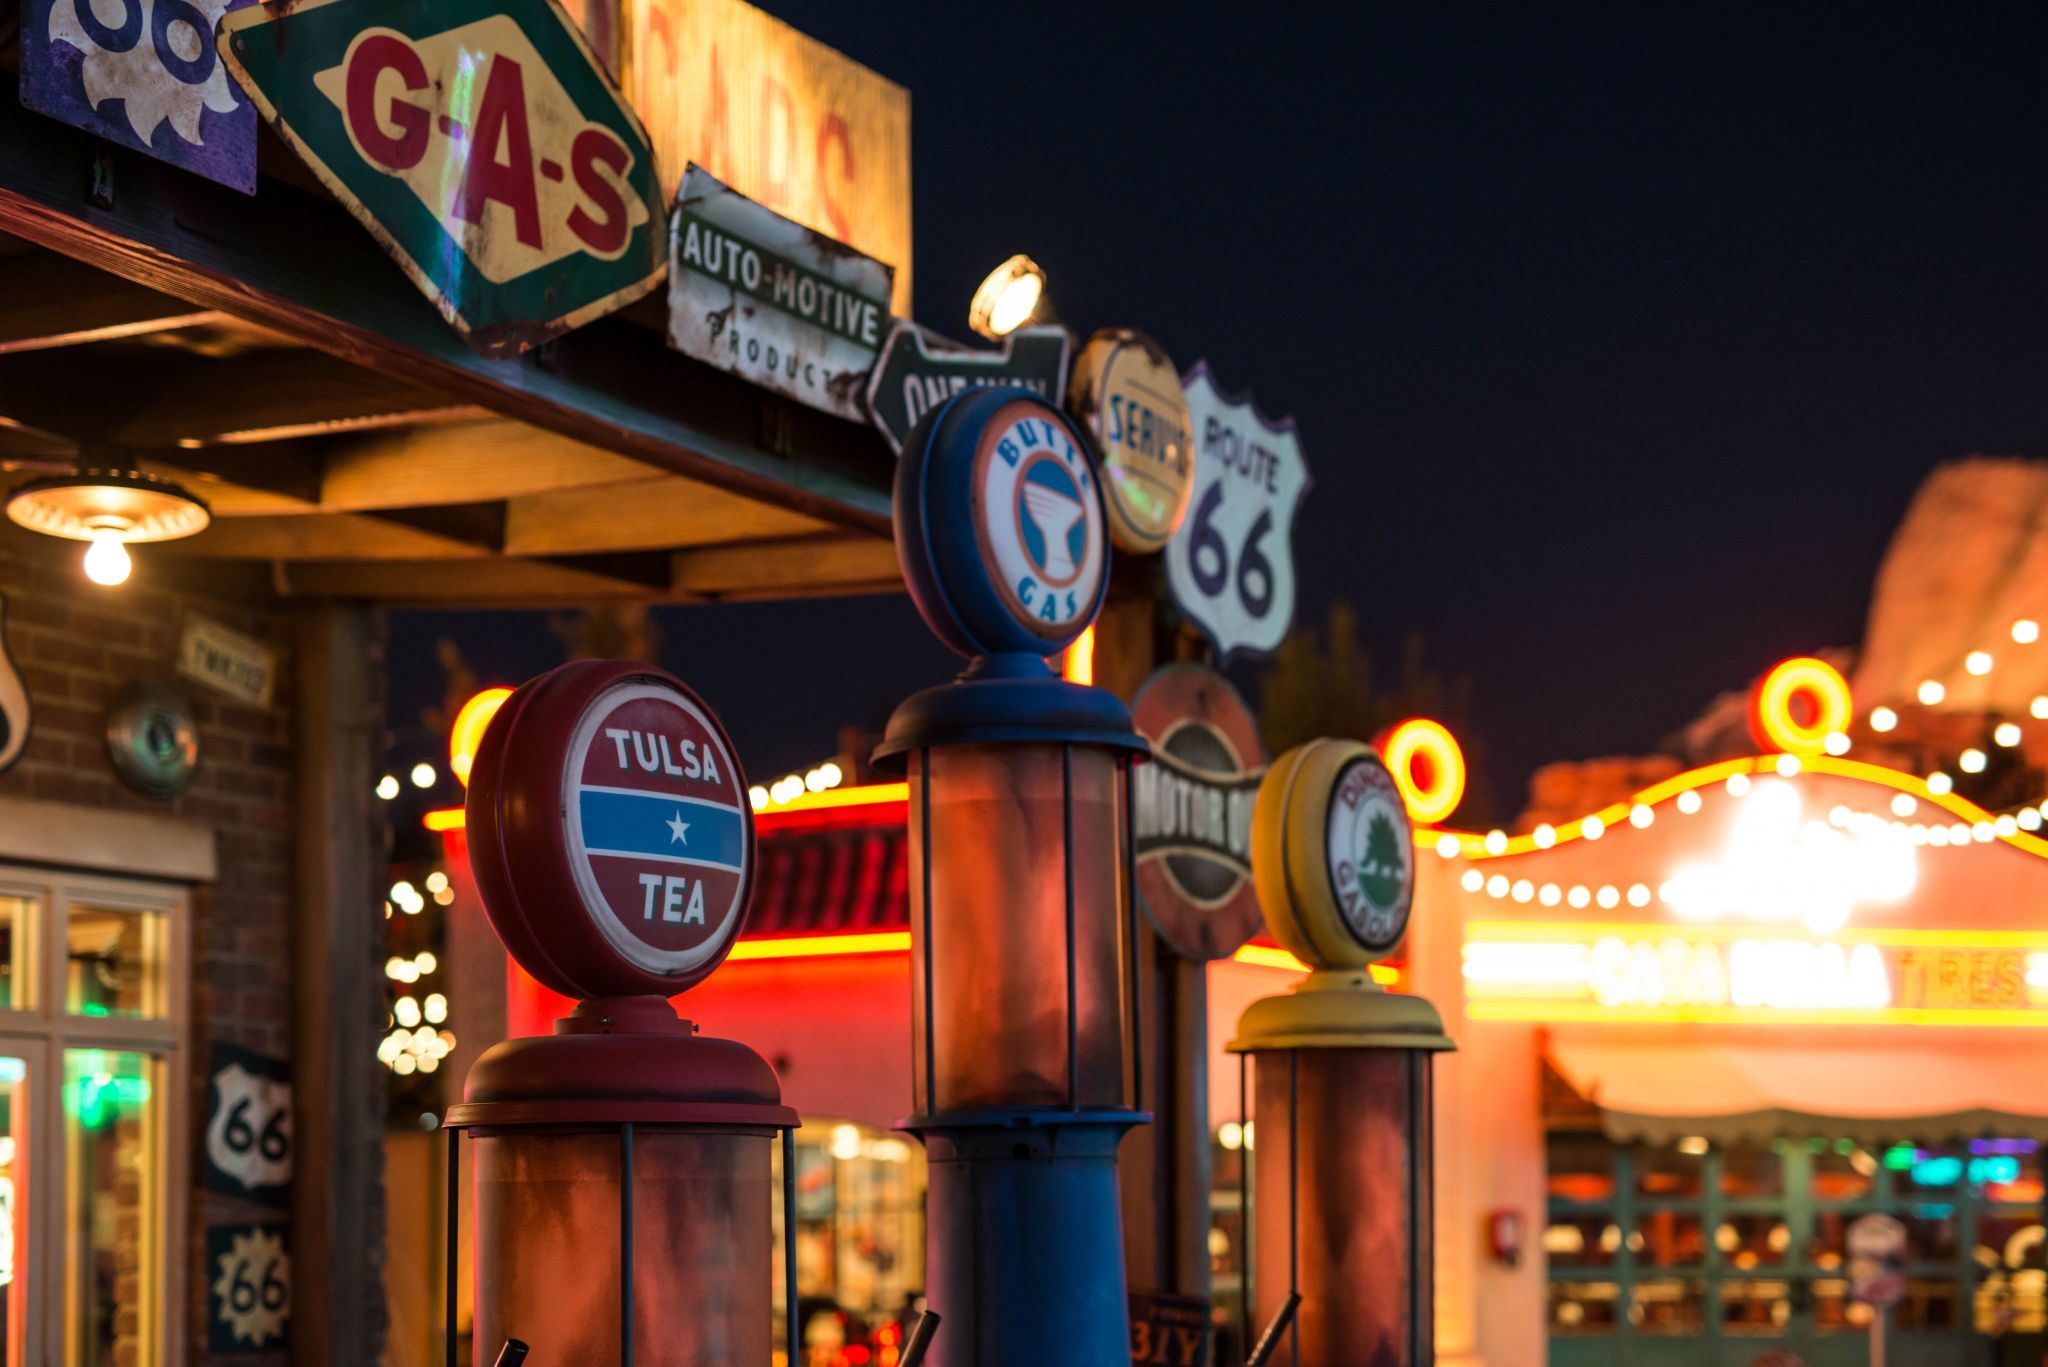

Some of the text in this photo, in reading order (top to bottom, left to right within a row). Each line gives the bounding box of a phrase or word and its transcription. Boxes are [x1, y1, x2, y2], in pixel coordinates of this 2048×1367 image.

[708, 315, 848, 396] PRODUCT
[1204, 415, 1281, 494] ROUTE
[1189, 478, 1275, 620] 66
[1018, 576, 1076, 622] GAS
[606, 728, 721, 785] TULSA
[639, 873, 705, 926] TEA
[222, 1097, 289, 1163] 66
[229, 1258, 288, 1313] 66
